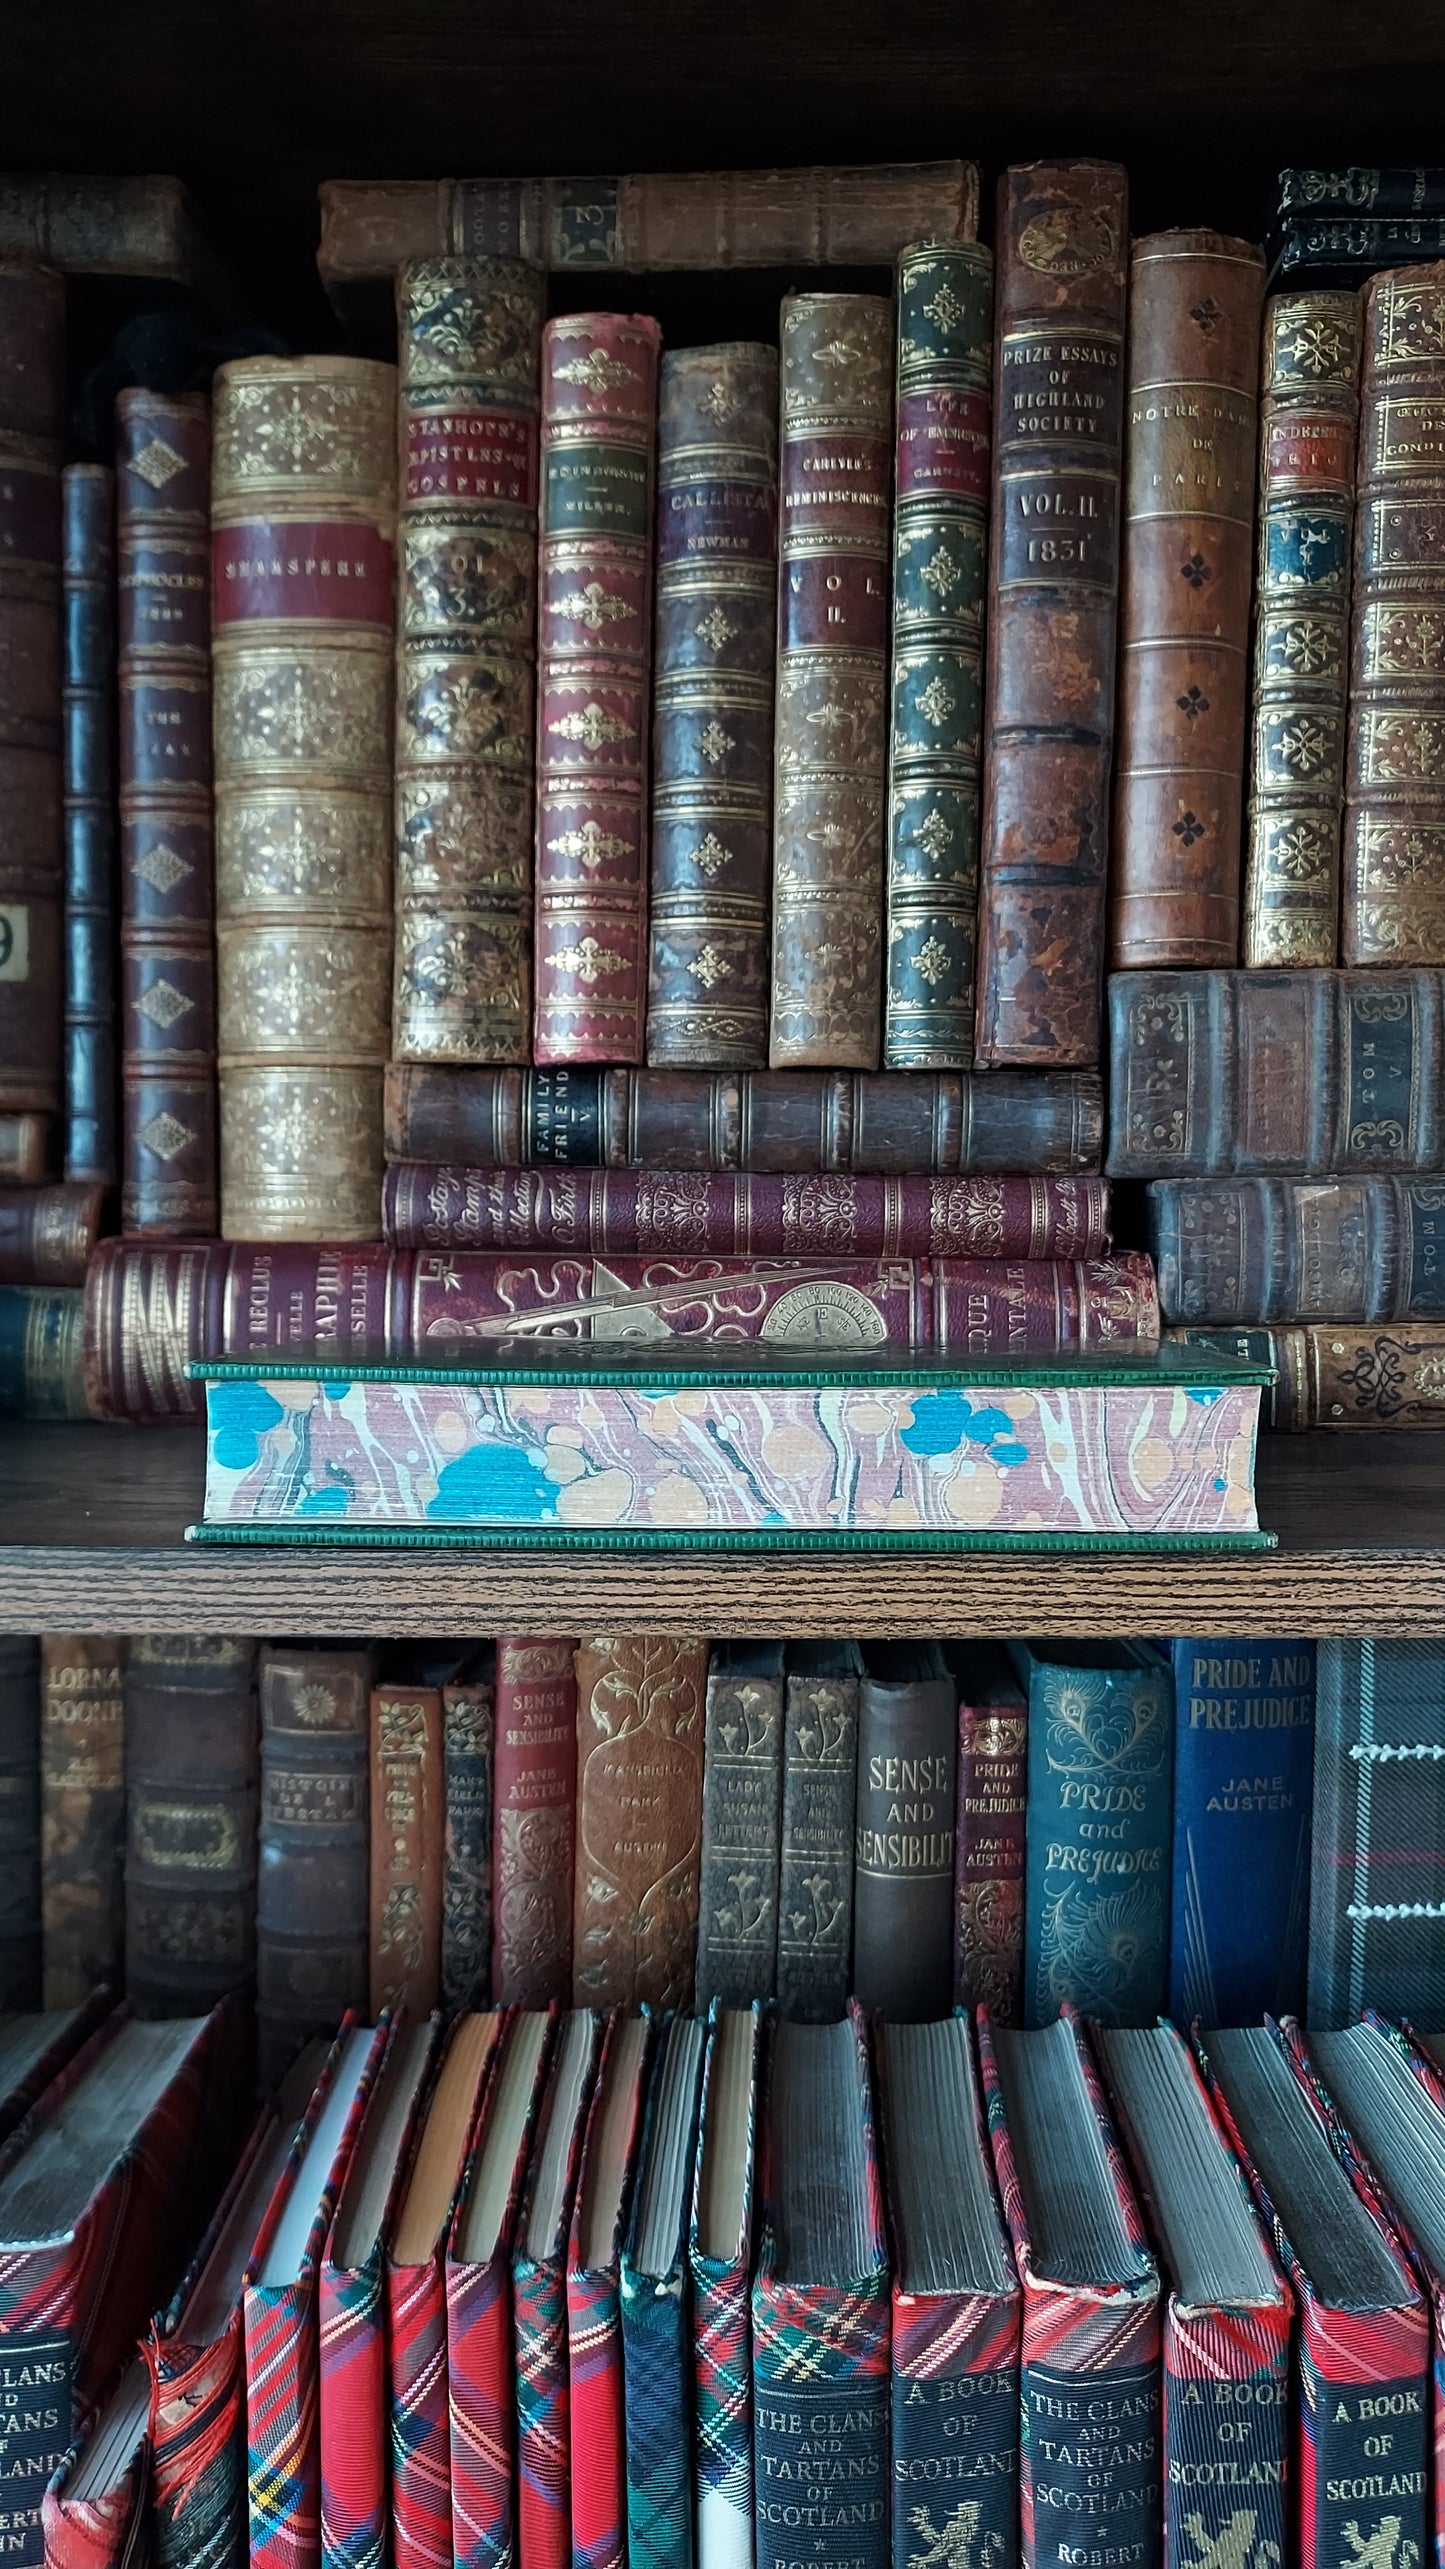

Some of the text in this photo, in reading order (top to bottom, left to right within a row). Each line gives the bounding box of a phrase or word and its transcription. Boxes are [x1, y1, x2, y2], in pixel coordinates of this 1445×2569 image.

[1003, 347, 1118, 367] PRIZE ESSAYS
[1049, 370, 1071, 385] OF
[926, 399, 968, 416] LIFE
[1013, 392, 1105, 410] HIGHLAND
[1017, 416, 1097, 433] SOCIETY
[900, 430, 917, 443] OF
[671, 492, 766, 511] CALLISTA
[687, 535, 749, 550] NEWMAN
[1027, 539, 1086, 563] 1831
[225, 558, 366, 579] SHAKSPERE
[1362, 1042, 1376, 1104] TOM
[536, 1074, 550, 1152] FAMILY
[554, 1071, 569, 1159] FRIEND
[424, 1166, 461, 1246] Postage
[249, 1255, 272, 1333] RECLUS
[827, 1286, 843, 1297] 100
[870, 1319, 881, 1335] 160
[47, 1666, 121, 1692] LORNA
[1193, 1657, 1311, 1690] PRIDE AND
[512, 1692, 564, 1711] SENSE
[523, 1713, 553, 1726] AND
[1188, 1697, 1310, 1730] PREJUDICE
[505, 1726, 569, 1745] SENSIBILITY
[517, 1768, 557, 1782] JANE
[869, 1754, 948, 1795] SENSE
[974, 1763, 1019, 1778] PRIDE
[508, 1781, 567, 1799] AUSTEN
[728, 1781, 761, 1794] LADY
[803, 1784, 837, 1798] SENSE
[982, 1782, 1011, 1794] AND
[1221, 1776, 1285, 1794] JANE
[965, 1797, 1025, 1814] PREJUDICE
[1060, 1781, 1147, 1813] PRIDE
[1205, 1793, 1293, 1812] AUSTEN
[723, 1803, 768, 1817] SUSAN
[886, 1803, 934, 1823] AND
[1079, 1819, 1130, 1841] and
[975, 1838, 1014, 1850] JANE
[966, 1853, 1022, 1868] AUSTEN
[1045, 1843, 1162, 1884] PREJUDICE
[904, 2373, 1015, 2405] A BOOK
[1180, 2382, 1204, 2405] A
[1030, 2389, 1157, 2421] THE CLANS
[1332, 2391, 1423, 2425] A BOOK
[757, 2407, 888, 2434] THE CLANS
[943, 2415, 978, 2437] OF
[1080, 2425, 1120, 2441] AND
[1218, 2422, 1252, 2442] OF
[798, 2440, 842, 2456] AND
[1039, 2437, 1154, 2467] TARTANS
[1363, 2435, 1393, 2456] OF
[761, 2455, 880, 2480] TARTANS
[895, 2449, 1017, 2482] SCOTLAND
[1087, 2472, 1114, 2488] OF
[1326, 2472, 1427, 2501] SCOTLAND
[807, 2487, 834, 2501] OF
[1036, 2483, 1157, 2514] SCOTLAND
[758, 2501, 884, 2527] SCOTLAND
[1057, 2541, 1145, 2566] ROBERT
